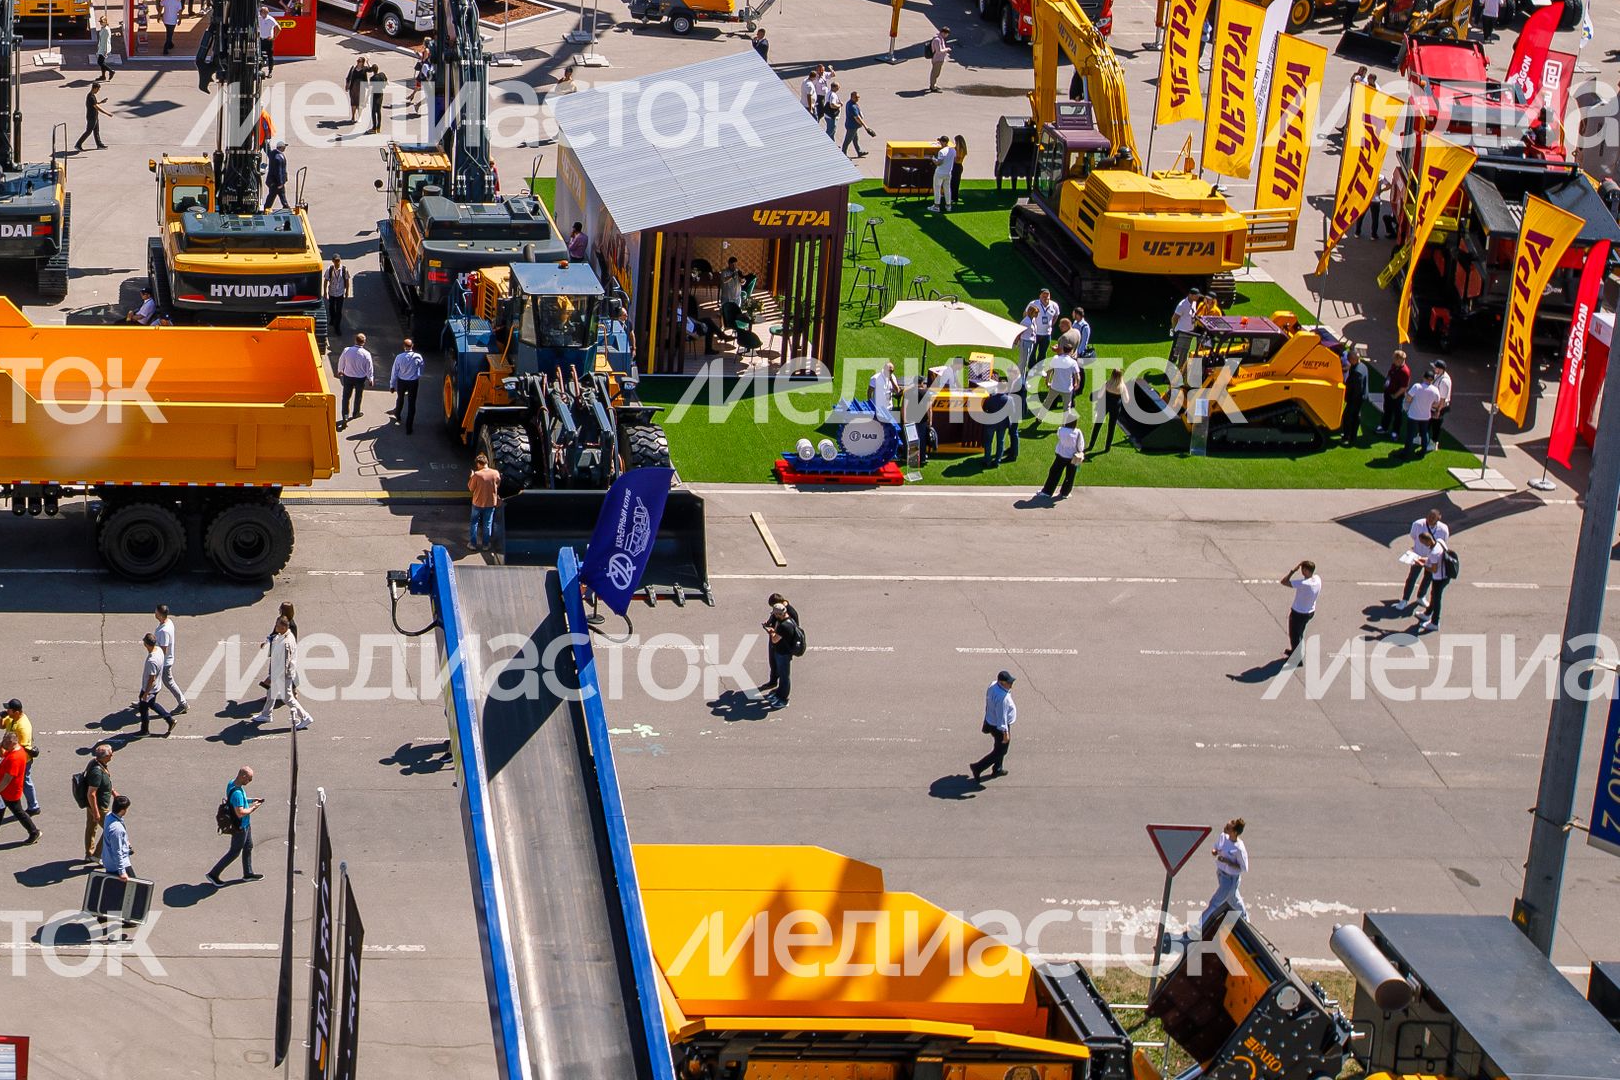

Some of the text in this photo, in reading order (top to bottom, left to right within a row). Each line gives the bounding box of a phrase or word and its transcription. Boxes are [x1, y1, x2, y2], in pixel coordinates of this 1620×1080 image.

[1215, 22, 1252, 156] ЧЕТРА
[1272, 61, 1311, 202] ЧЕТРА
[752, 209, 831, 227] ЧЕТРА
[1142, 240, 1216, 257] ЧЕТРА
[210, 284, 289, 297] HYUNDAI
[1508, 228, 1555, 396] ЧЕТРА
[1572, 302, 1590, 361] DRAGON
